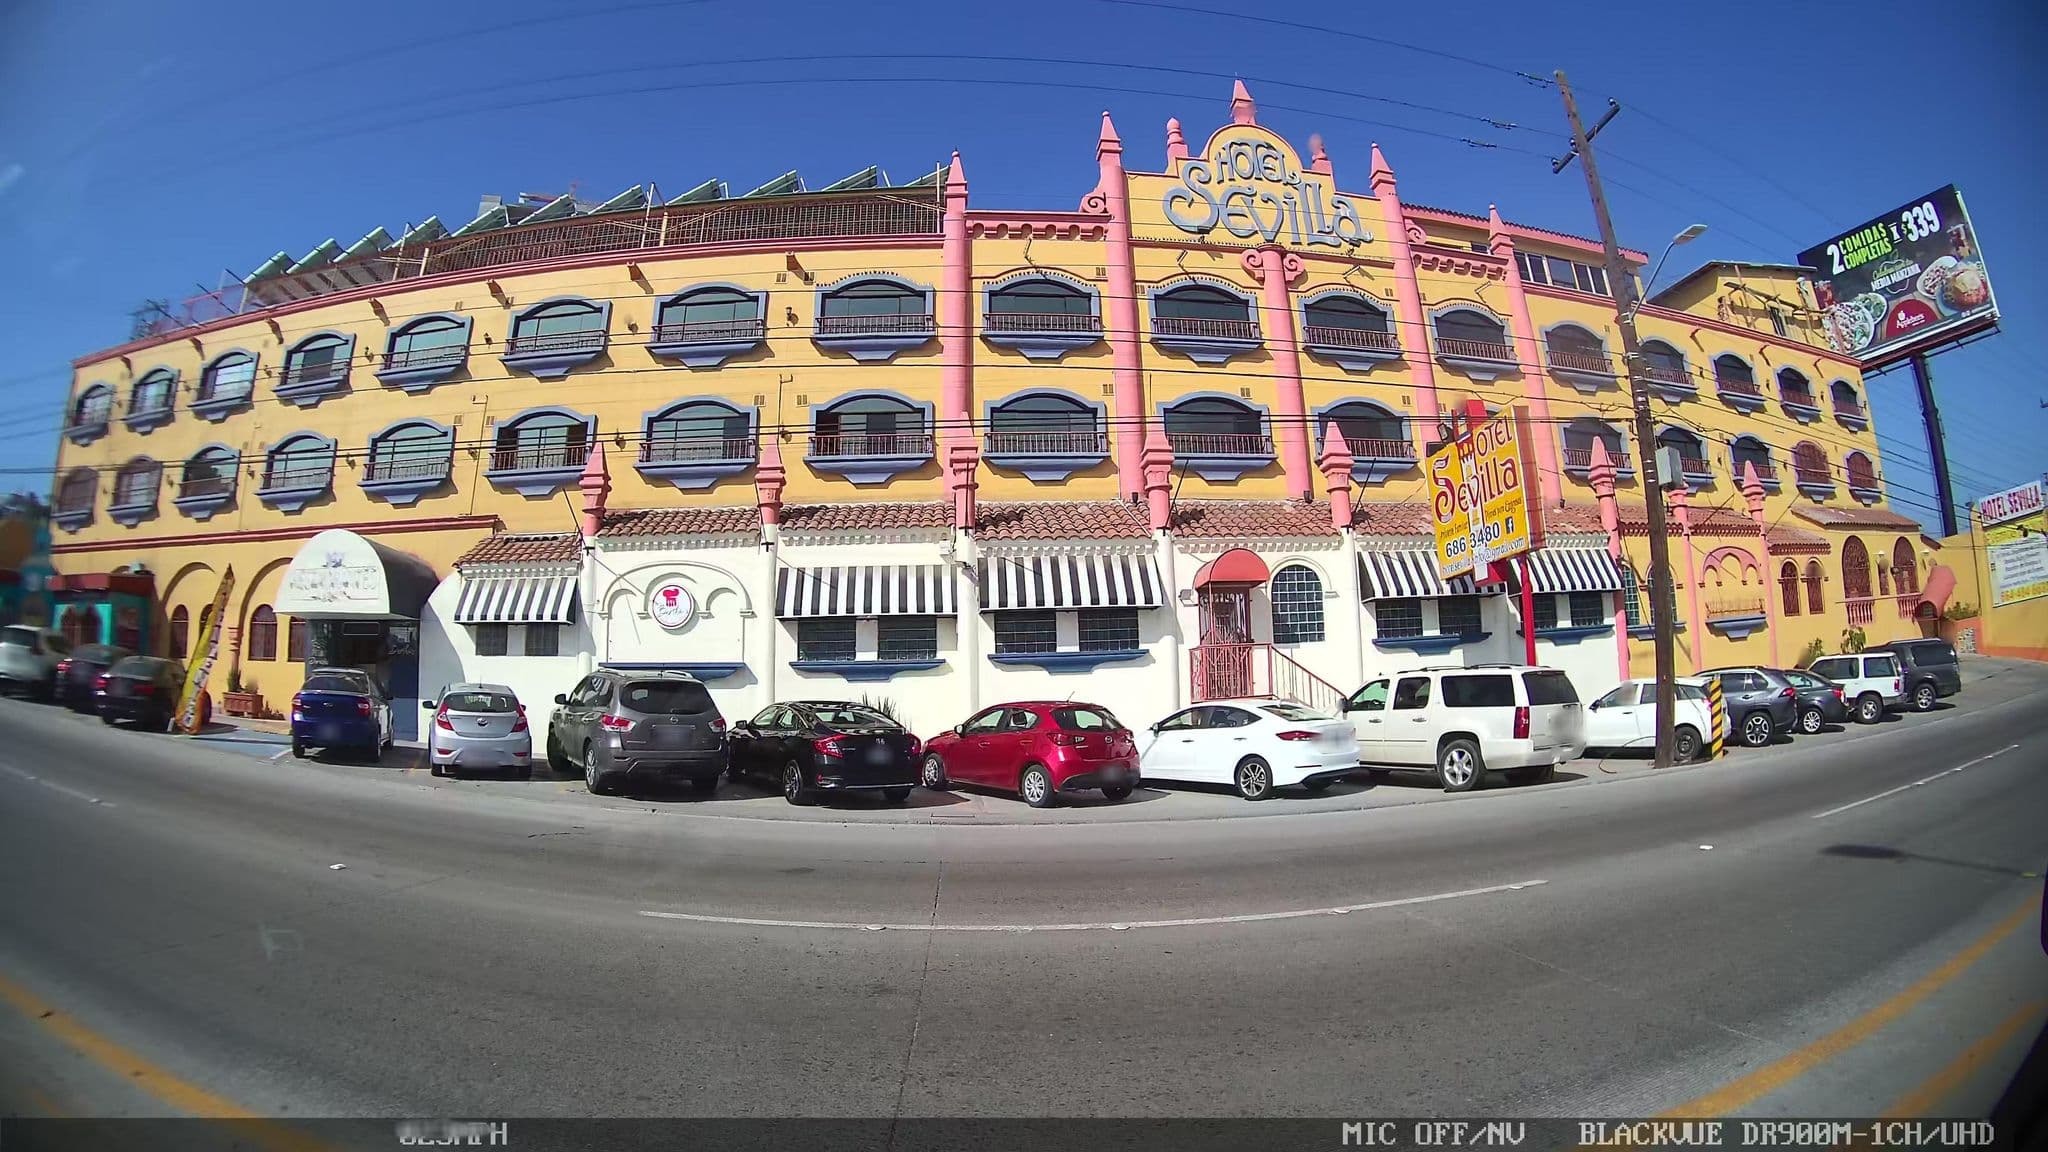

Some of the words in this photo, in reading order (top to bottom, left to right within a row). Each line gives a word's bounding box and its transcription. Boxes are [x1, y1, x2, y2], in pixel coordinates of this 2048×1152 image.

[1216, 139, 1301, 185] HOTEL
[1827, 244, 1845, 275] 2
[1839, 223, 1887, 254] COMIDAS
[1843, 238, 1892, 269] COMPLETAS
[1432, 451, 1519, 524] Sevilla
[1446, 536, 1466, 558] 686
[1469, 521, 1500, 549] 3480
